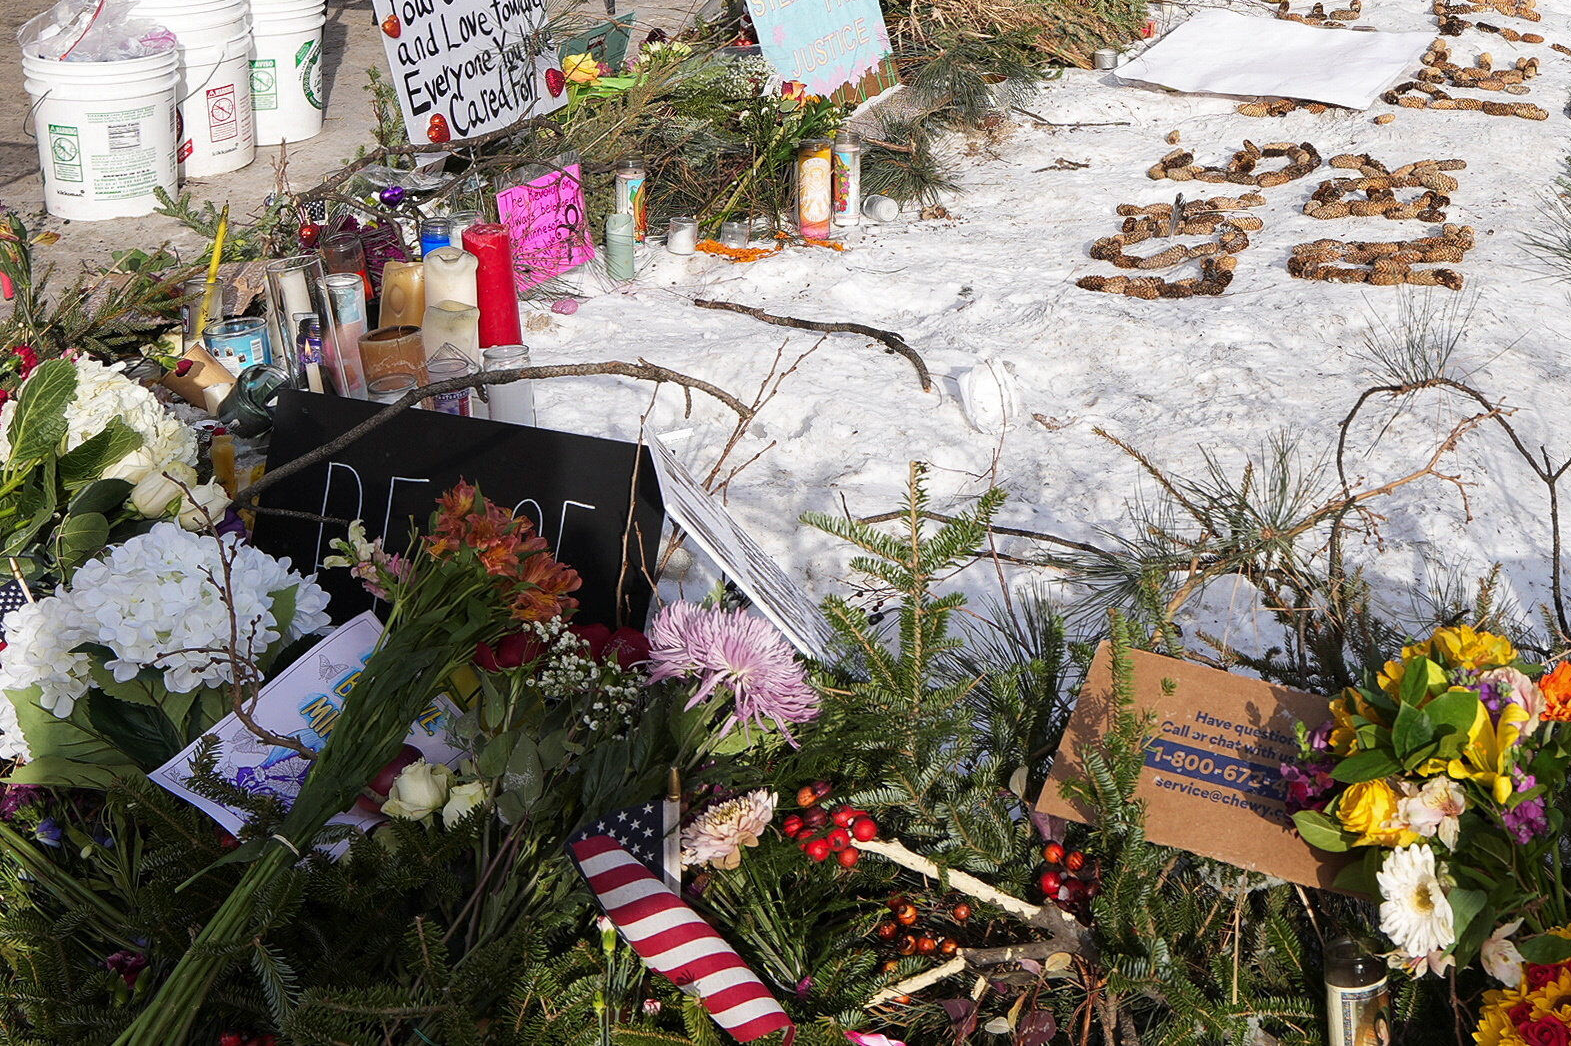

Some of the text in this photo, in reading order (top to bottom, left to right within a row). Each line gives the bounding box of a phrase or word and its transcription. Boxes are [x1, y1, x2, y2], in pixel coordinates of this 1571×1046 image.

[398, 22, 440, 66] and
[441, 10, 493, 52] Love
[793, 18, 871, 78] JUSTICE
[404, 47, 496, 117] Everyone
[449, 64, 514, 137] Cared
[1161, 721, 1296, 764] Call or chat with us
[1195, 711, 1232, 730] Have
[1154, 777, 1285, 817] service@chewy.c
